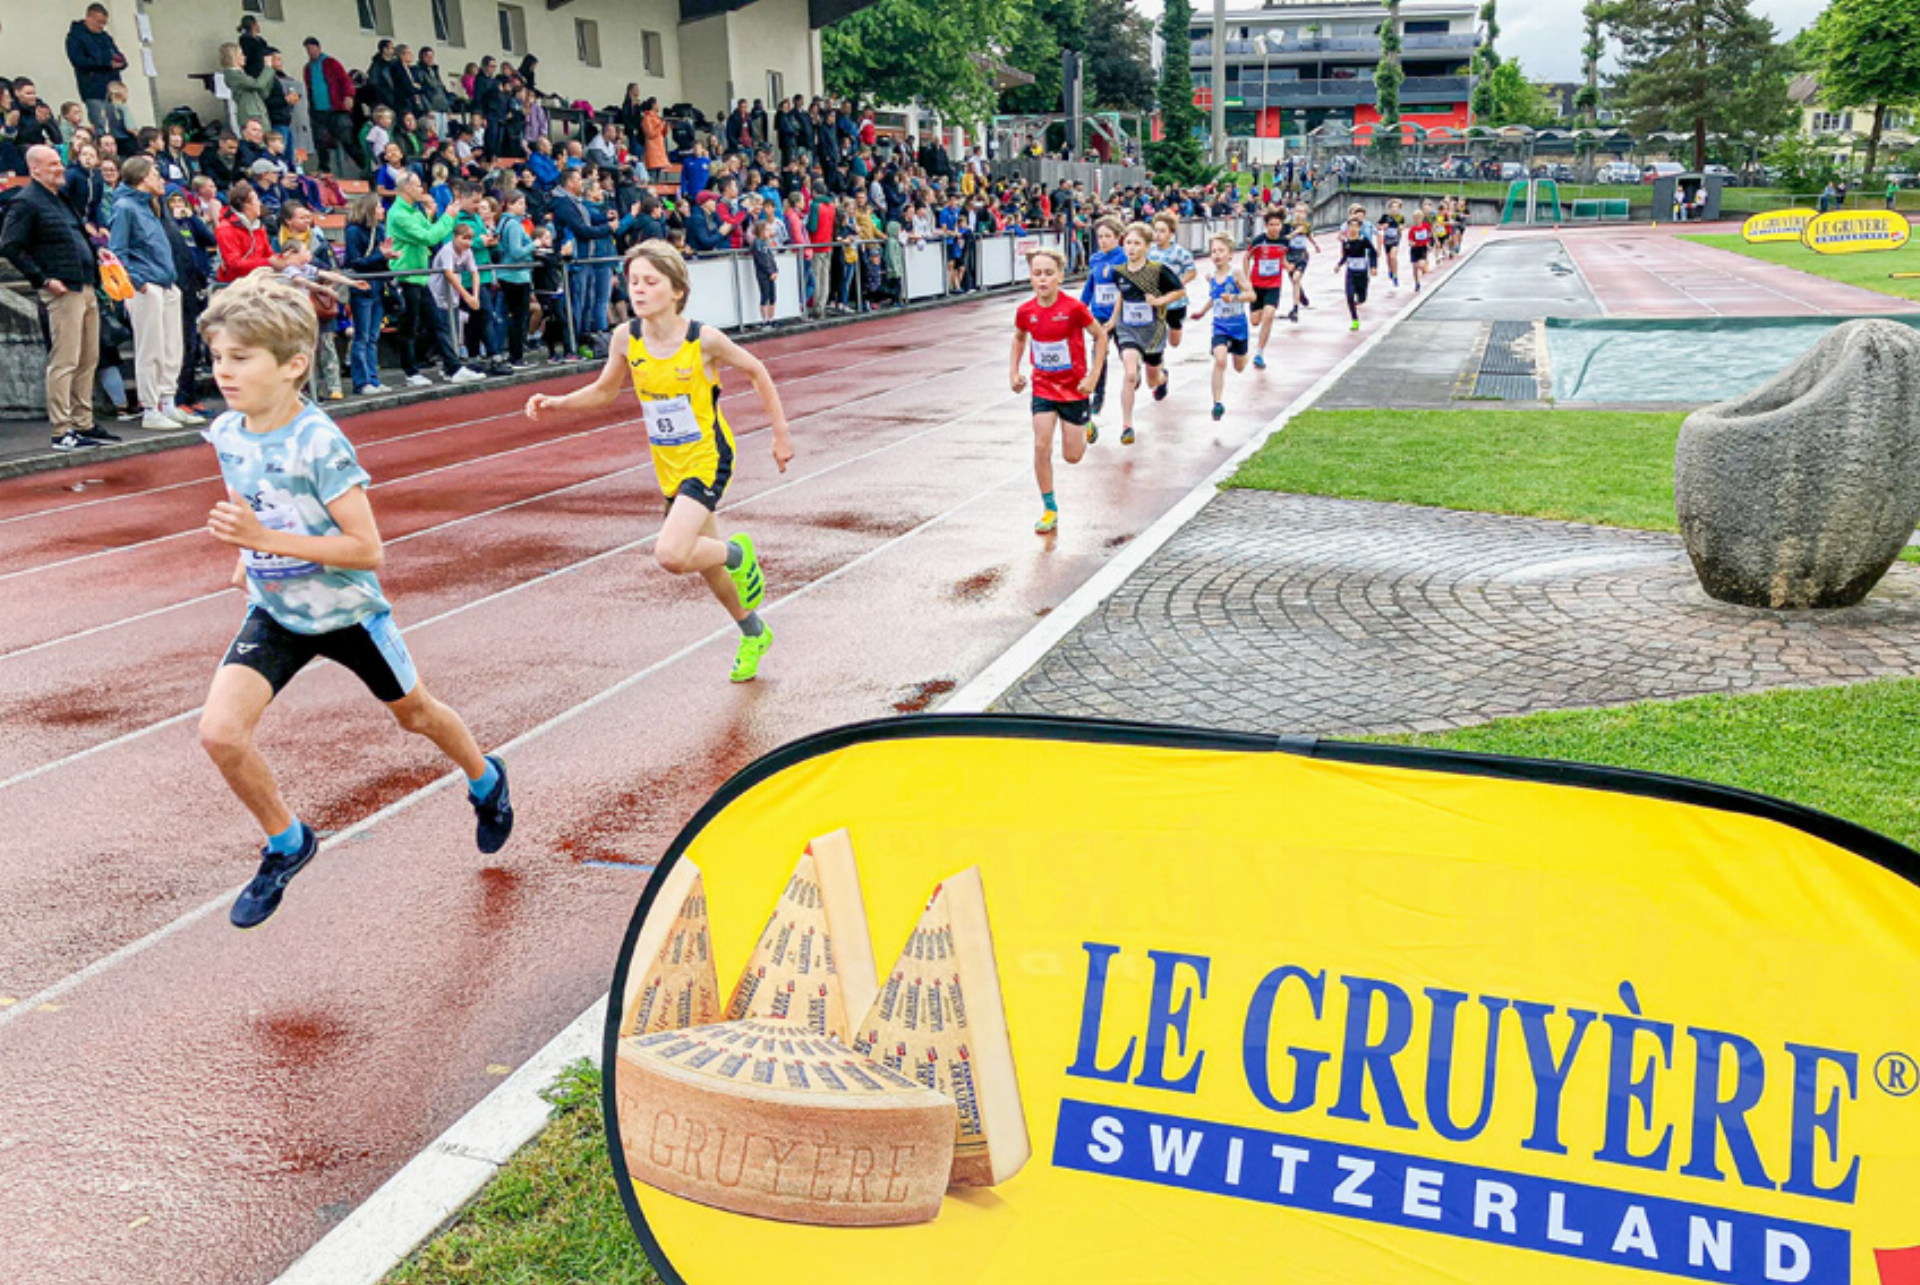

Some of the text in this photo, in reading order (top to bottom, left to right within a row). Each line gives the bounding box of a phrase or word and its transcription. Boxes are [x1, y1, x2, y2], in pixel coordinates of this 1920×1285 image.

[656, 417, 675, 433] 63
[1066, 942, 1210, 1094] LE
[649, 1108, 915, 1204] GRUYÈRE
[1088, 1117, 1811, 1283] SWITZERLAND
